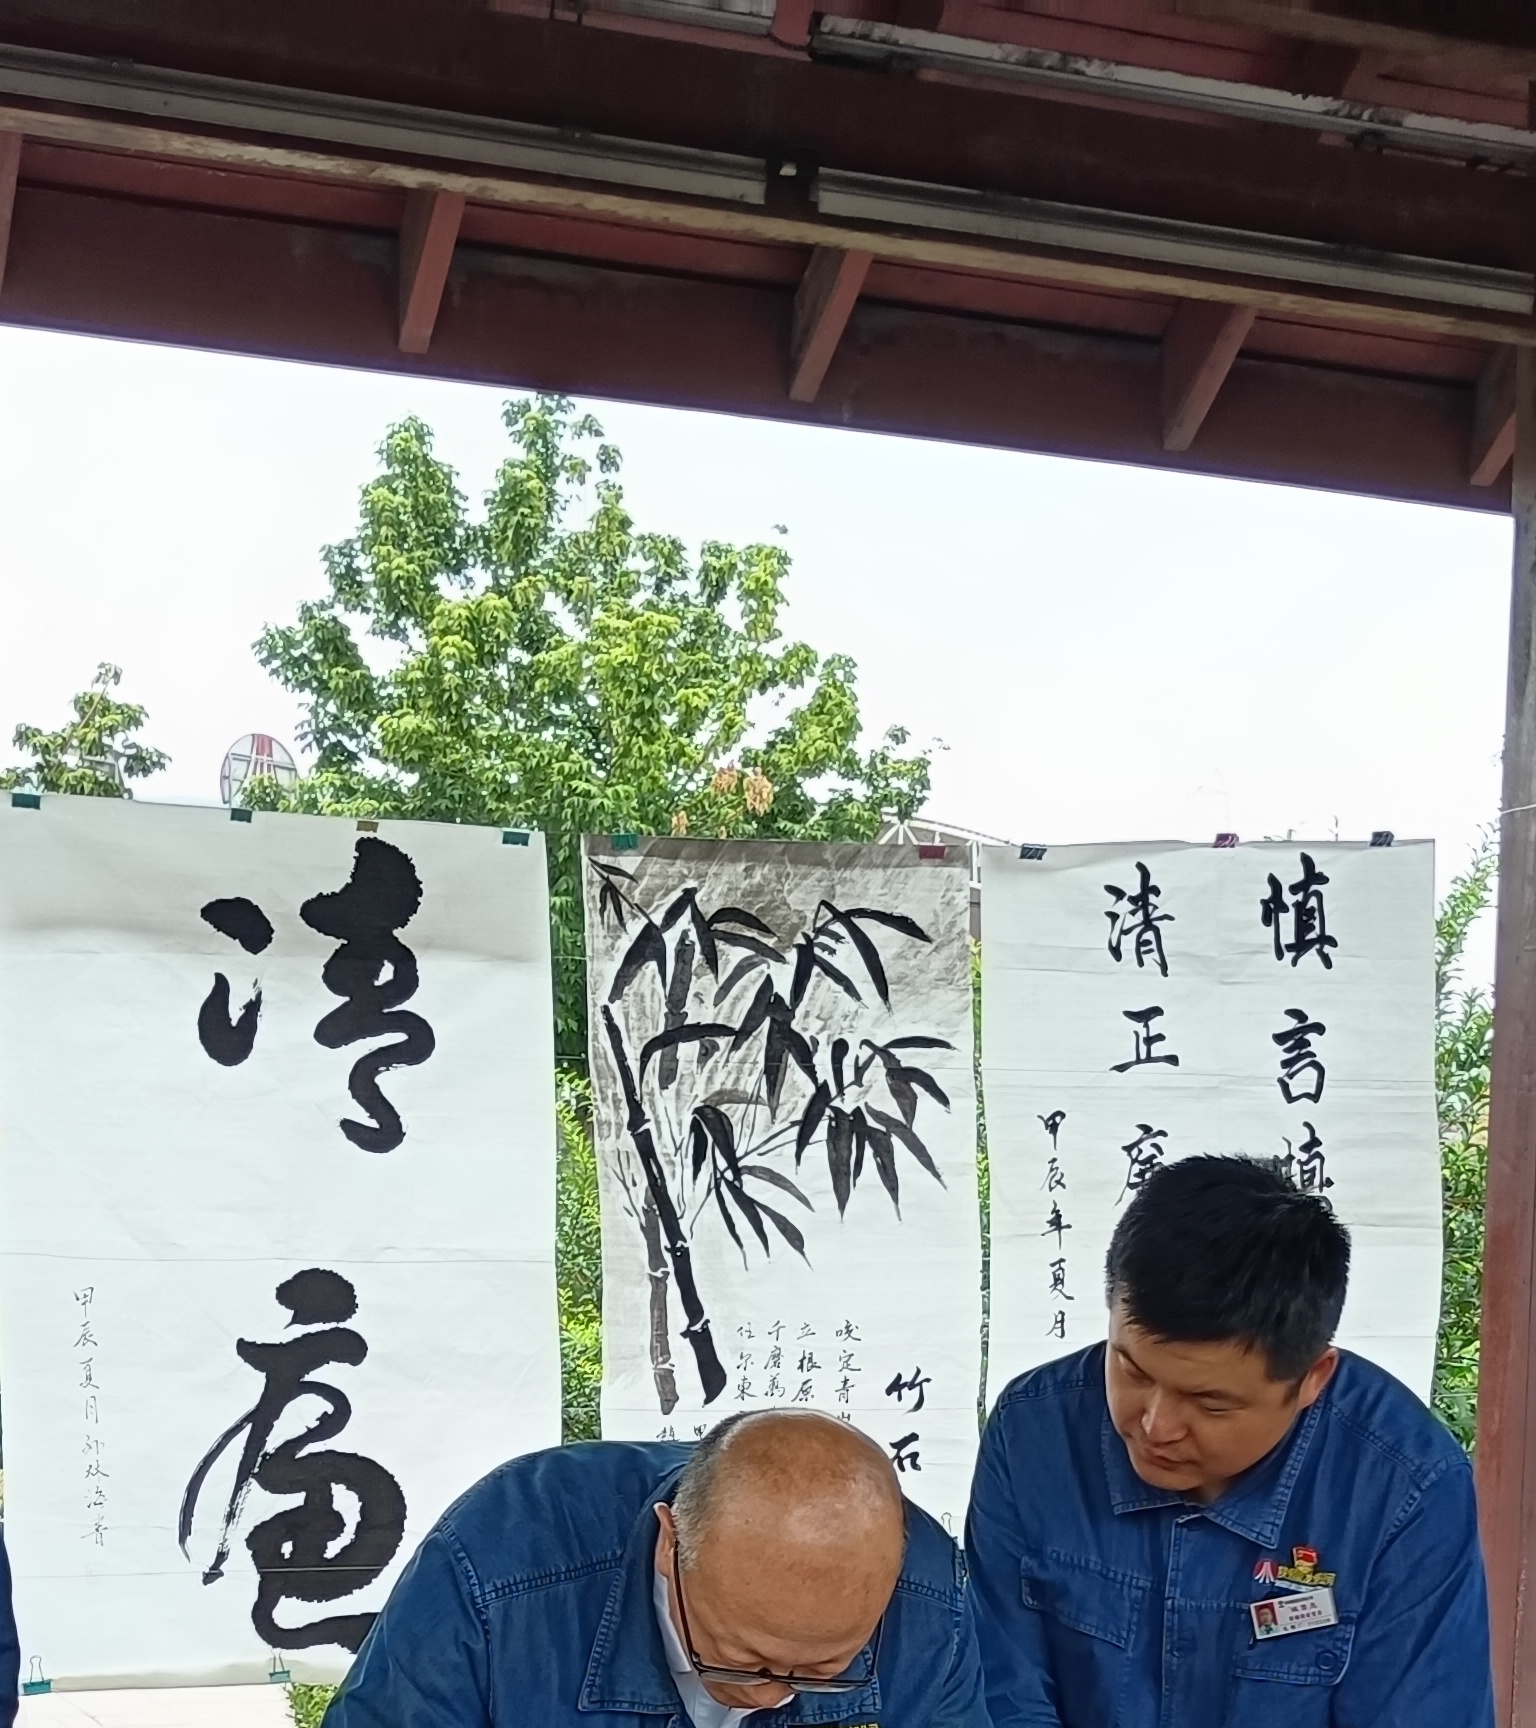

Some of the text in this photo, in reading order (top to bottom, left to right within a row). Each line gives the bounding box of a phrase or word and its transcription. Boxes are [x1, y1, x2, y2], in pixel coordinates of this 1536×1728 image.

[1037, 1110, 1074, 1339] 甲辰年夏月
[884, 1366, 933, 1473] 竹石
